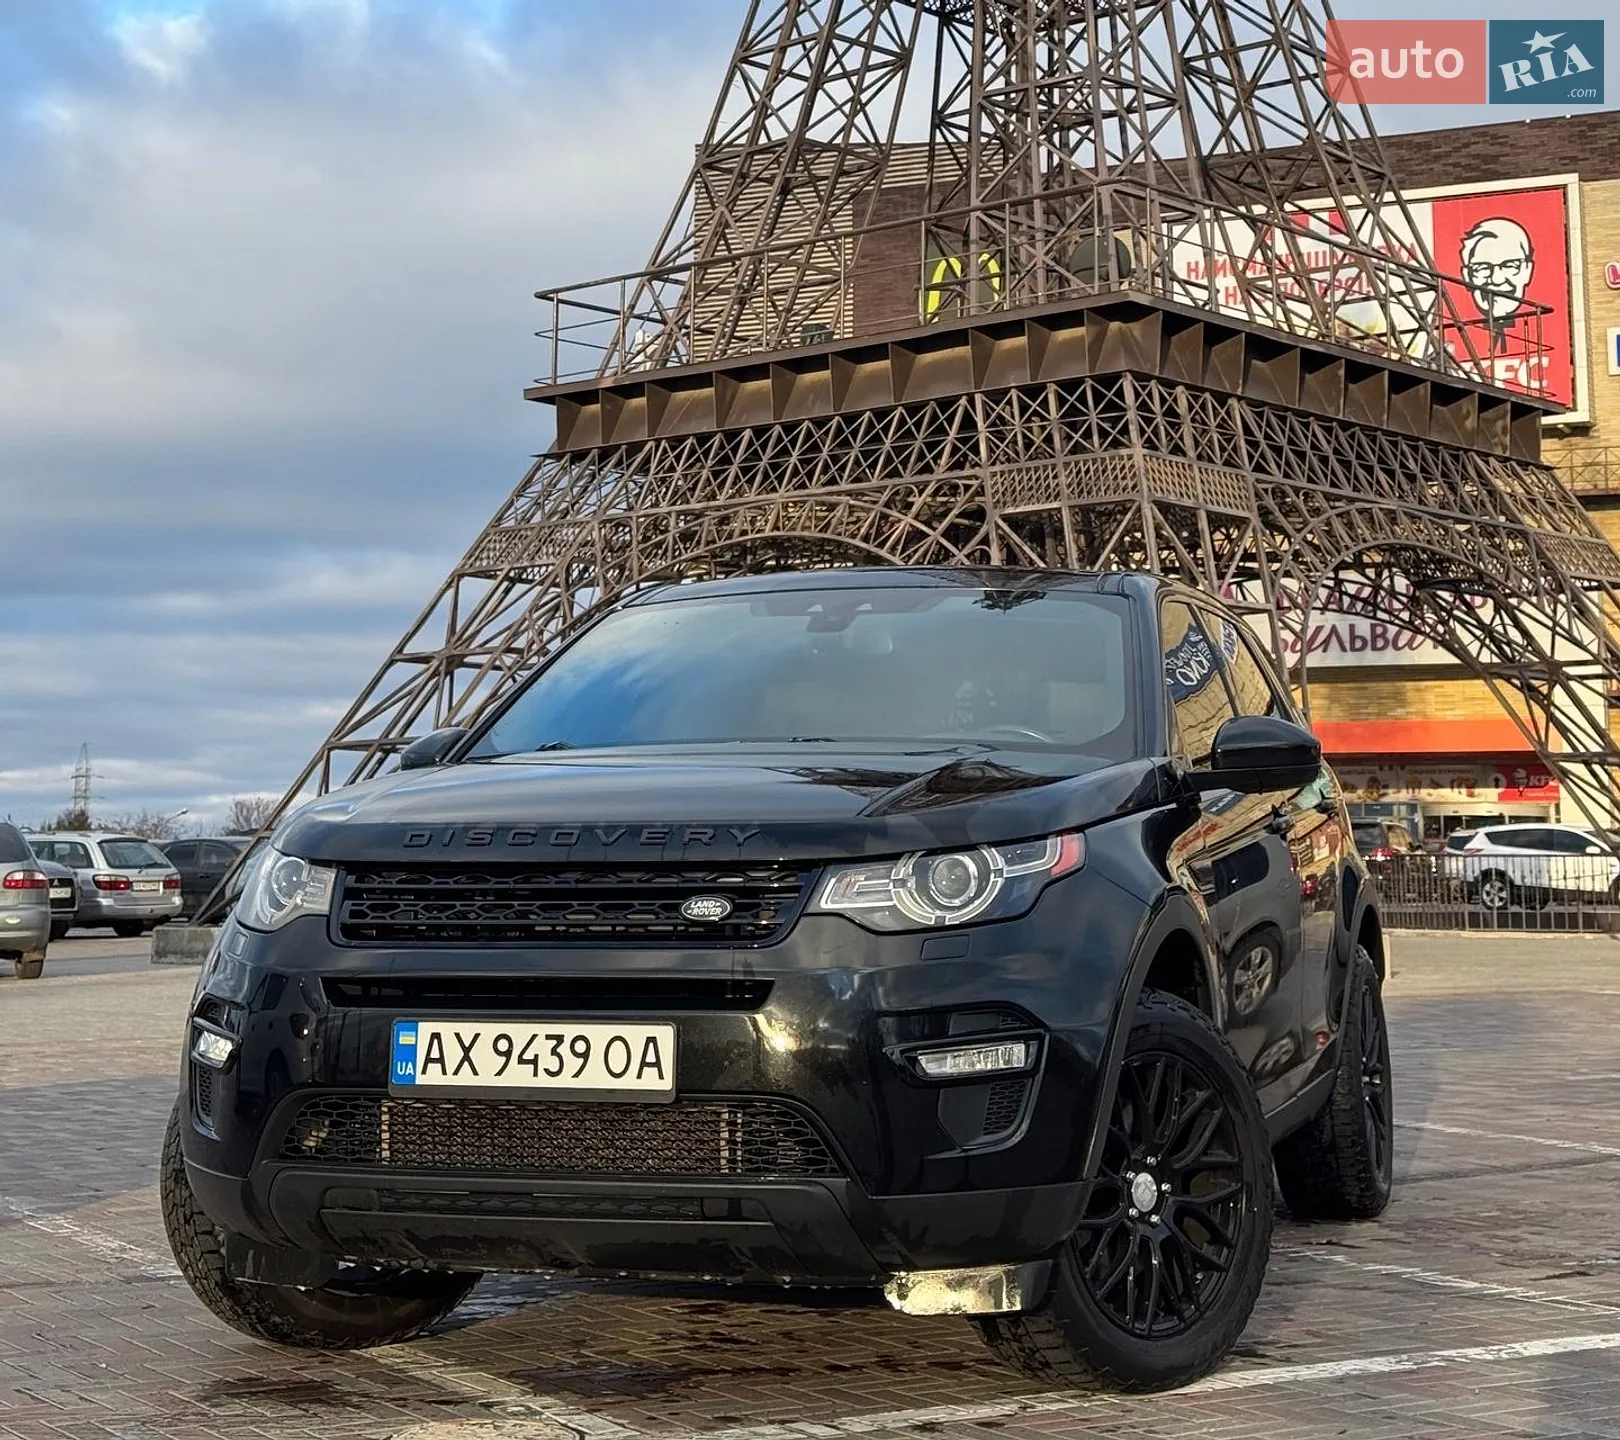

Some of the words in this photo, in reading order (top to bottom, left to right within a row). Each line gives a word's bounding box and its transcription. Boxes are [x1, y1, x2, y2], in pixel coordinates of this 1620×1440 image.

[402, 826, 763, 848] DISCOVERY
[420, 1032, 481, 1076] AX
[492, 1033, 591, 1078] 9439
[603, 1035, 665, 1080] OA
[396, 1061, 414, 1076] UA
